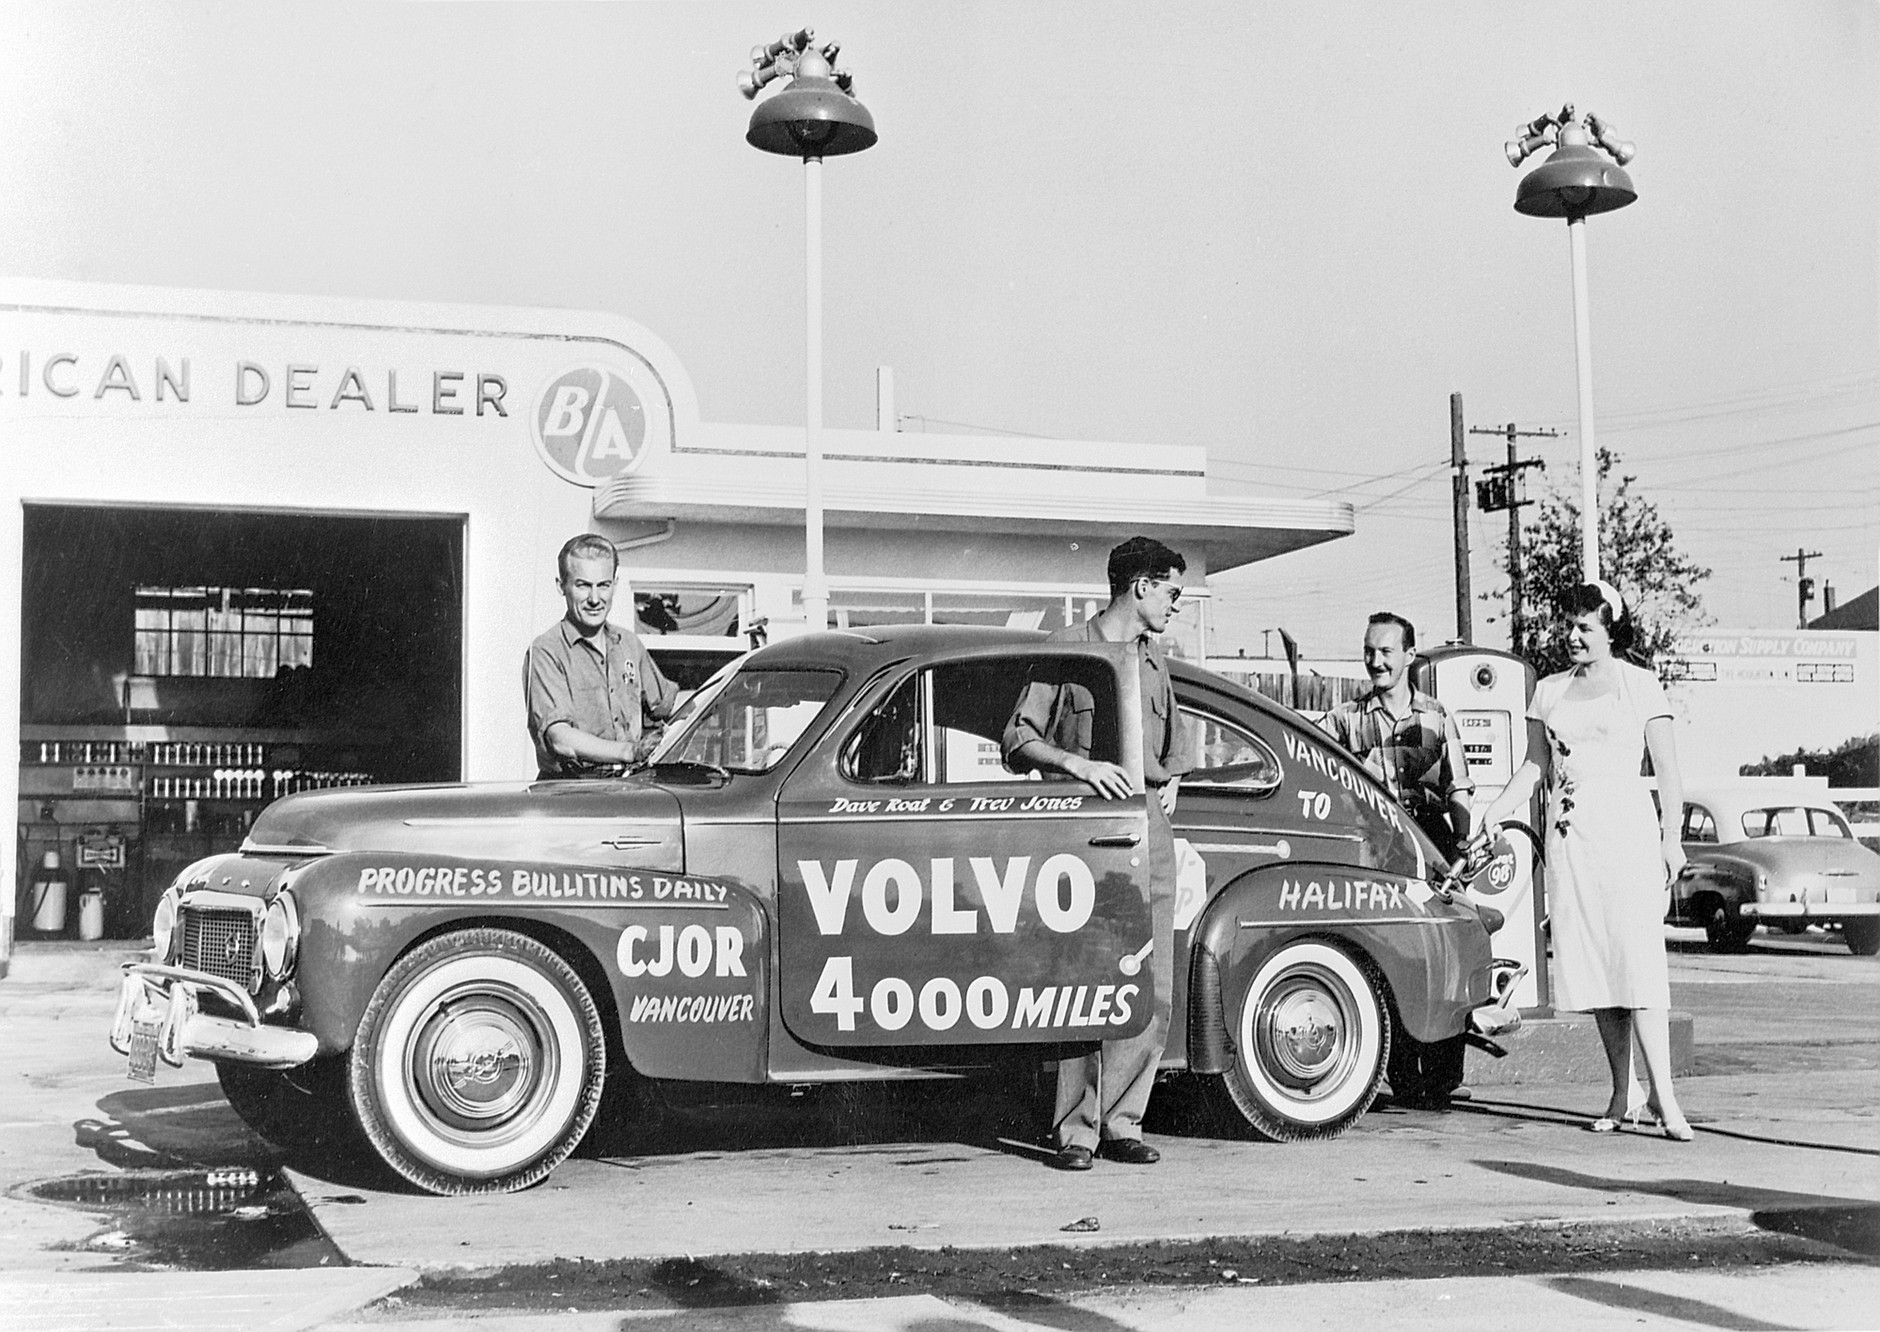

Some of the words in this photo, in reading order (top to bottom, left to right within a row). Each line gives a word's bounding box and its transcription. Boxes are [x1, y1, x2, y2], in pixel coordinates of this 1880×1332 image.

[0, 349, 191, 402] ICAN
[235, 361, 509, 417] DEALER
[1282, 730, 1403, 833] VANCOUVER
[828, 797, 882, 813] Dave
[969, 797, 1015, 812] Trev
[1020, 795, 1084, 811] Jones
[1297, 789, 1332, 820] TO
[357, 867, 502, 897] PROGRESS
[511, 869, 644, 900] BULLITINS
[652, 877, 728, 902] DAILY
[797, 853, 1096, 935] VOLVO
[1278, 880, 1404, 910] HALIFAX
[616, 924, 748, 978] CJOR
[629, 993, 754, 1023] VANCOUVER
[809, 956, 1010, 1031] 4000
[1011, 984, 1140, 1030] MILES
